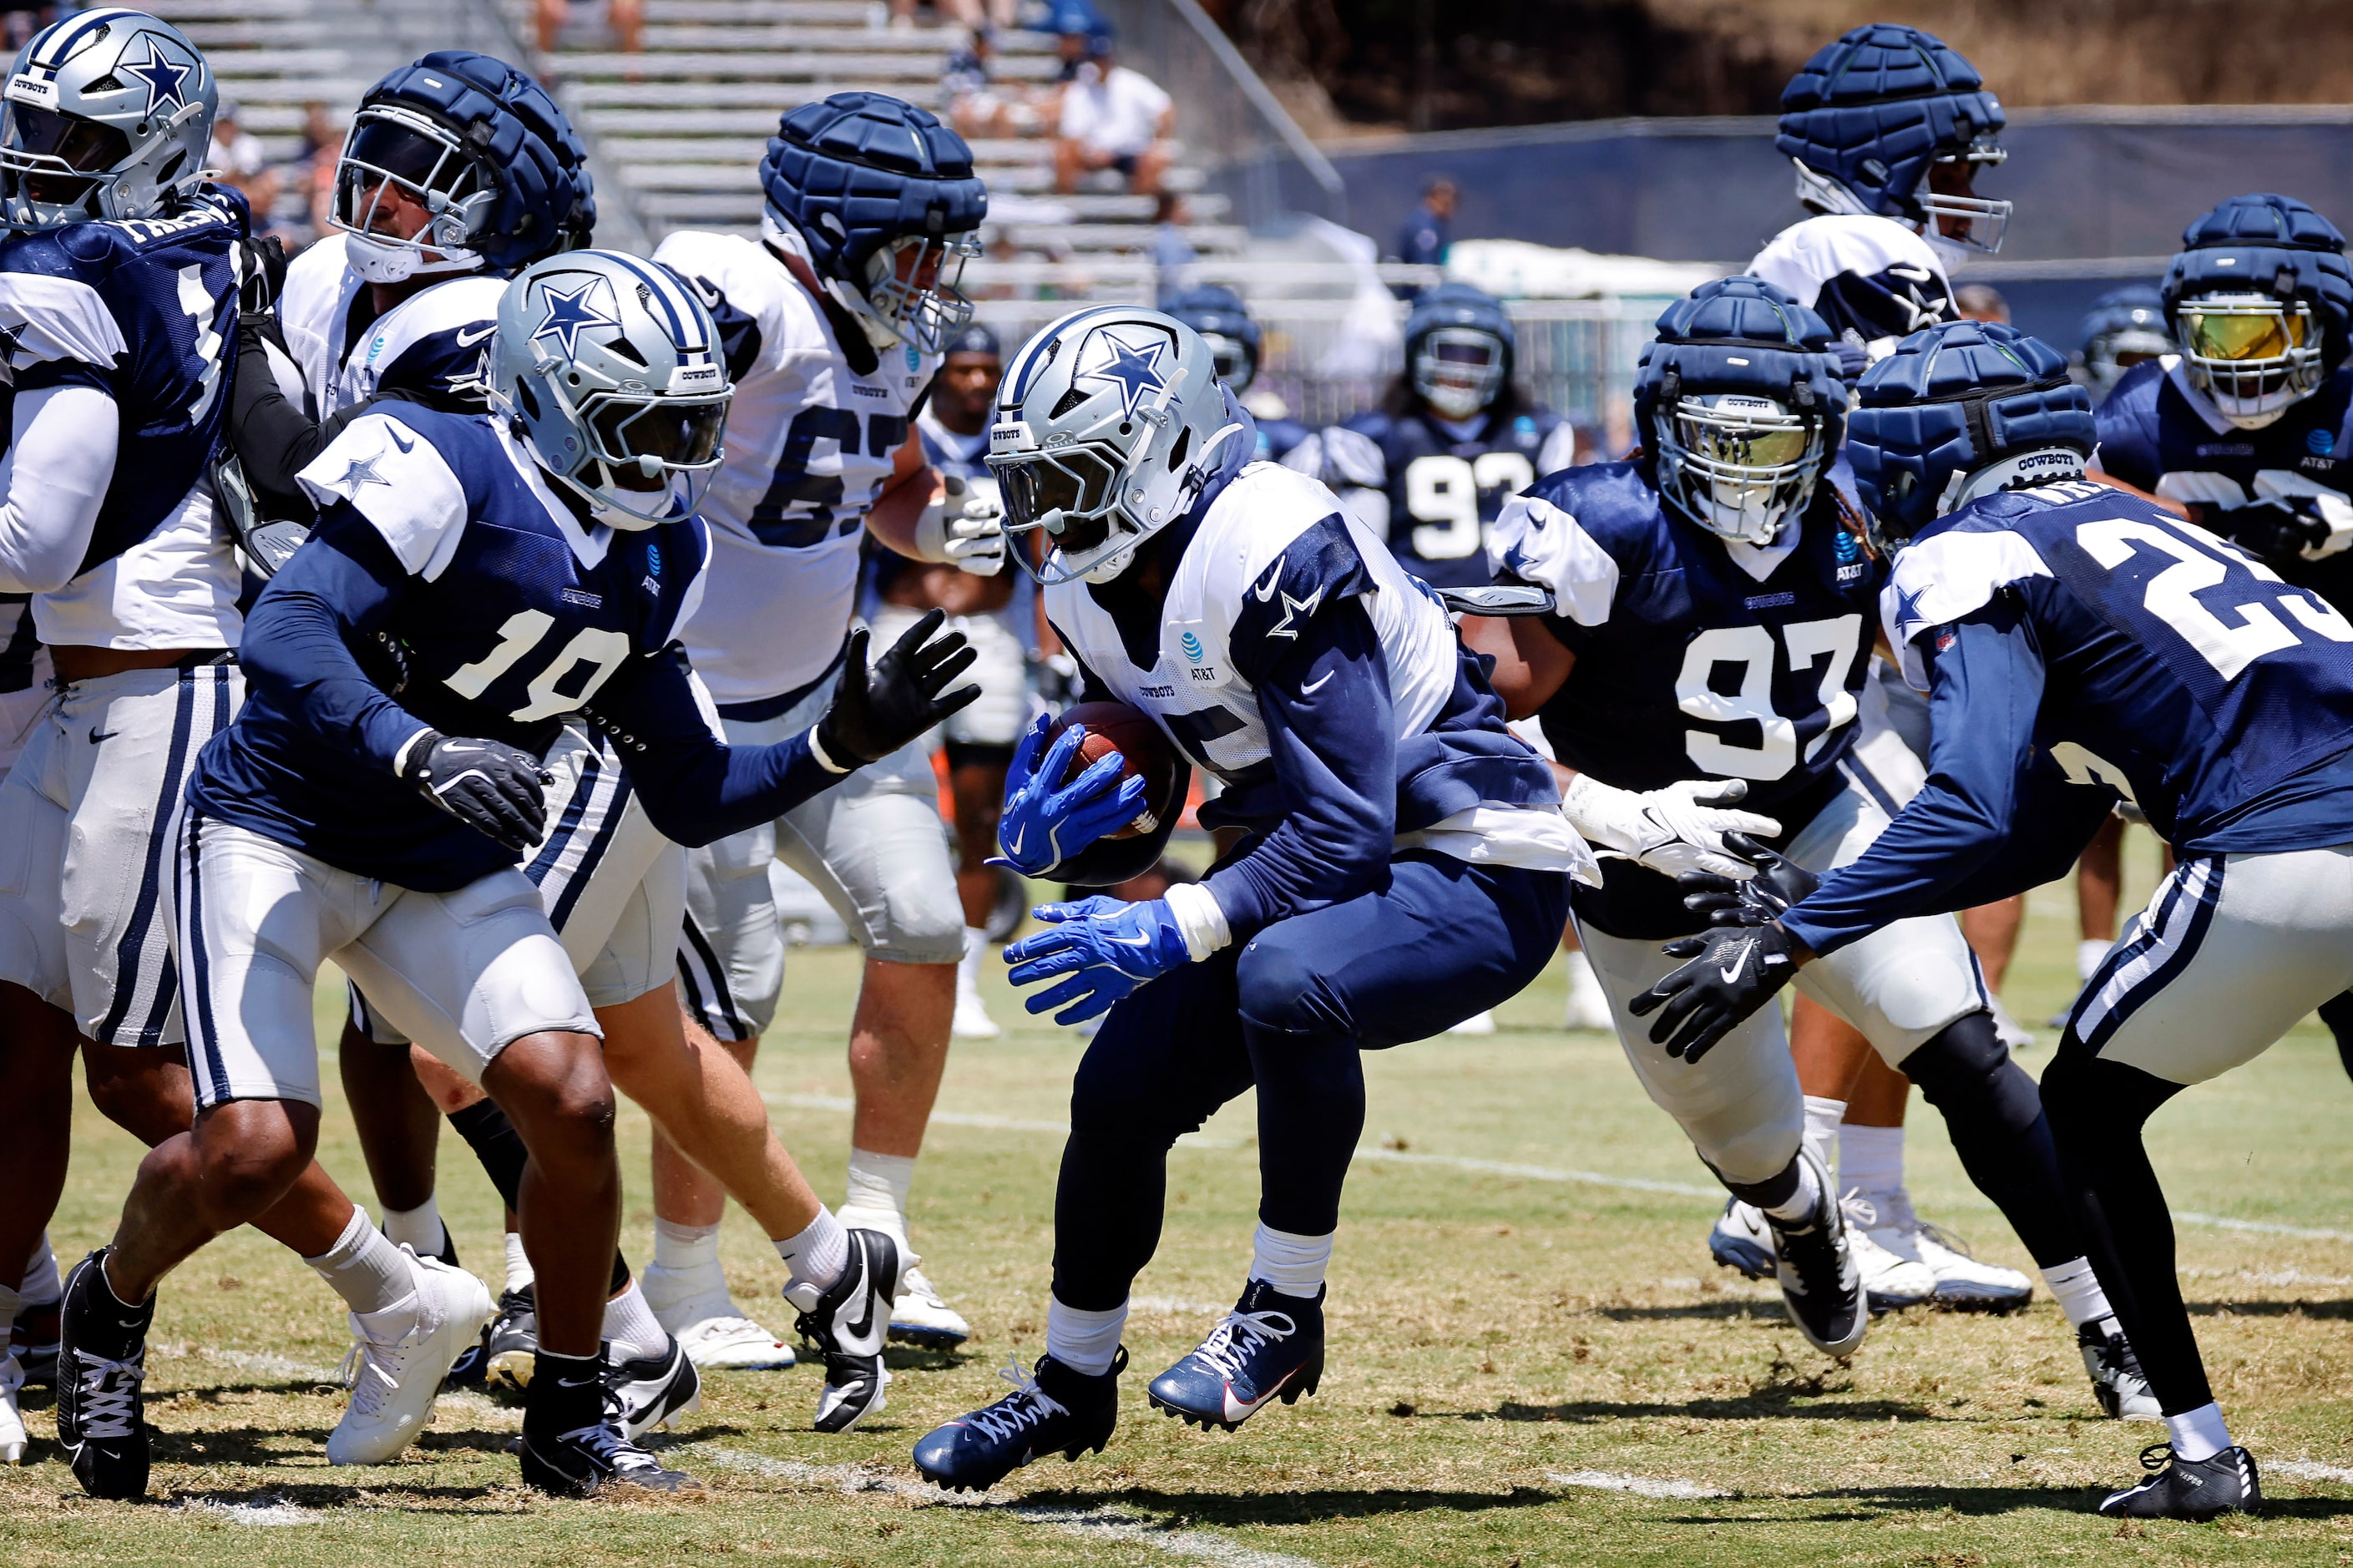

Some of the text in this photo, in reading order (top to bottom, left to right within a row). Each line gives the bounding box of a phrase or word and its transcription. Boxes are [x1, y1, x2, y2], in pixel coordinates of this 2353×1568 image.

[14, 79, 48, 94] COWBOYS
[1043, 438, 1075, 450] OAKLEY
[2018, 453, 2075, 471] COWBOYS
[1836, 564, 1864, 581] AT&T
[1191, 667, 1216, 680] AT&T
[1675, 613, 1863, 781] 97
